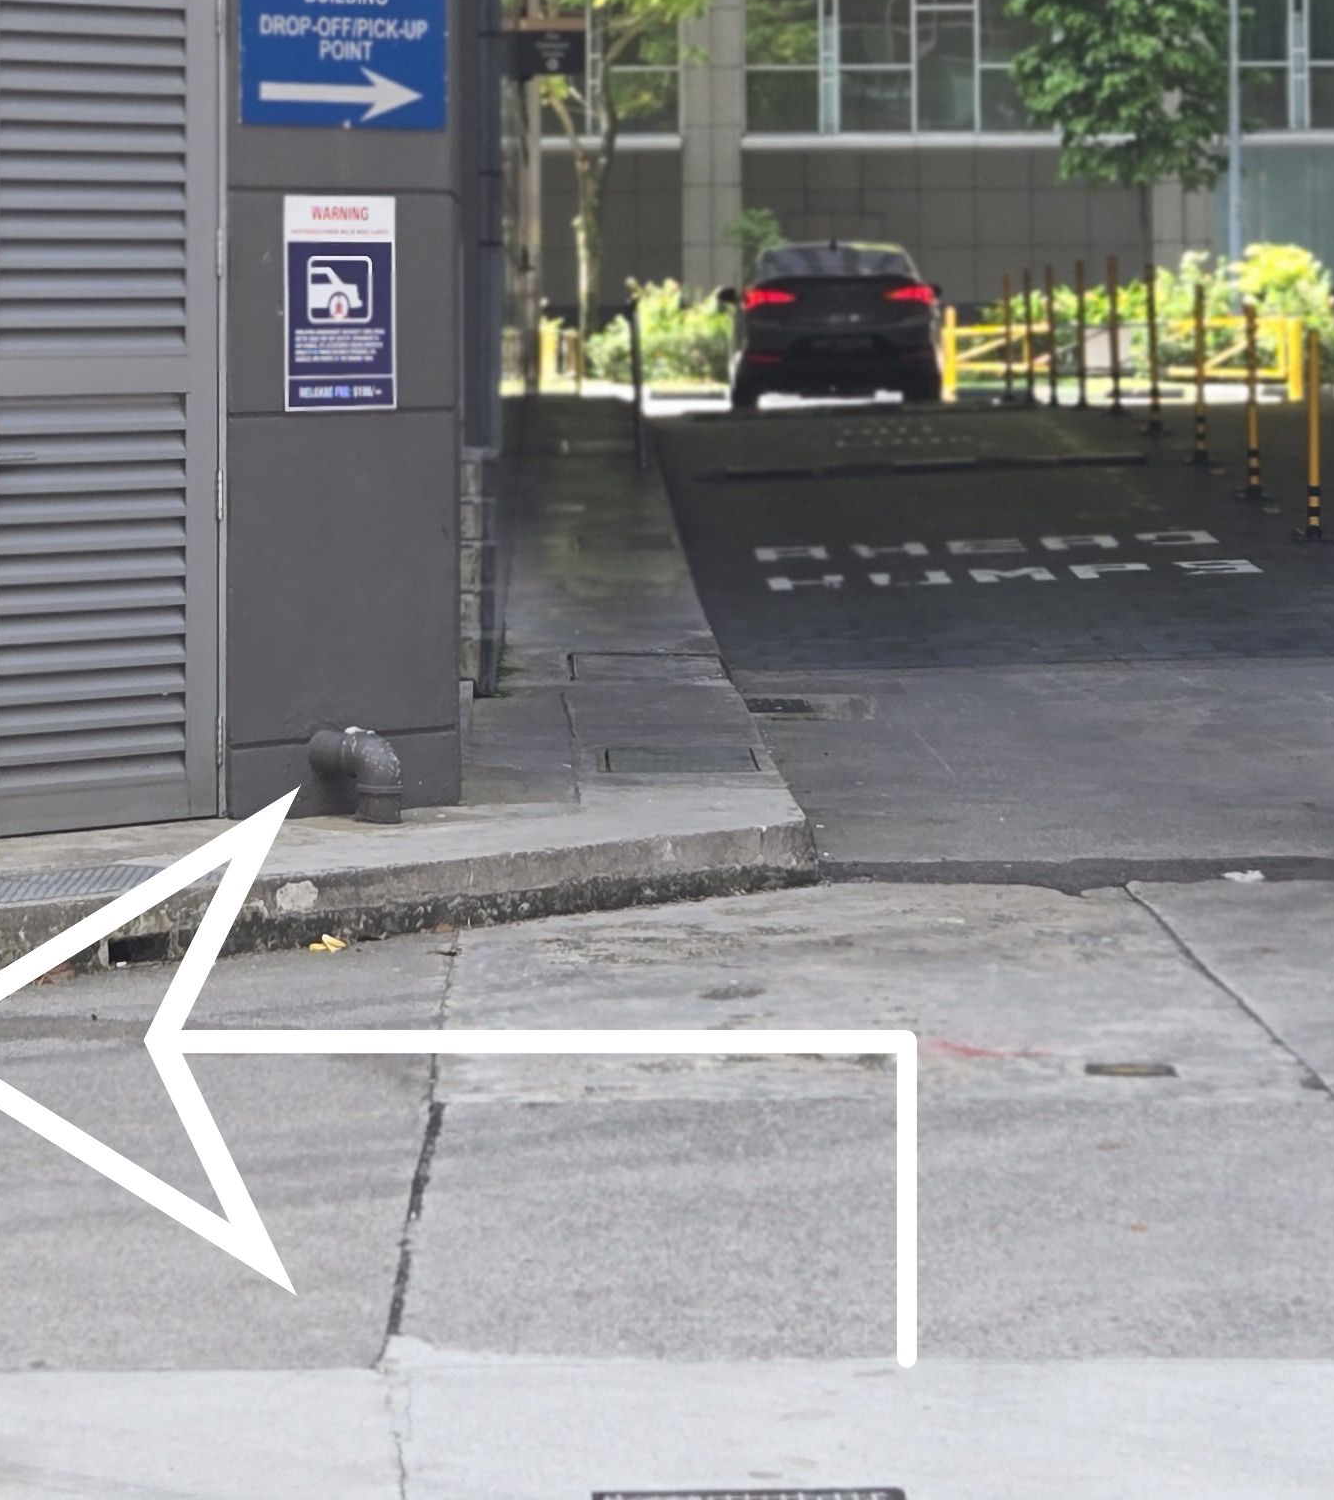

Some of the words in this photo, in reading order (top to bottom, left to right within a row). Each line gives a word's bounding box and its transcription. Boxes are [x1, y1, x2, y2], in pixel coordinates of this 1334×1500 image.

[259, 14, 428, 40] DROP-OFF/PICK-UP
[319, 40, 373, 61] POINT
[311, 206, 369, 220] WARNING
[754, 529, 1220, 562] AHEAD
[767, 558, 1264, 591] HUMPS
